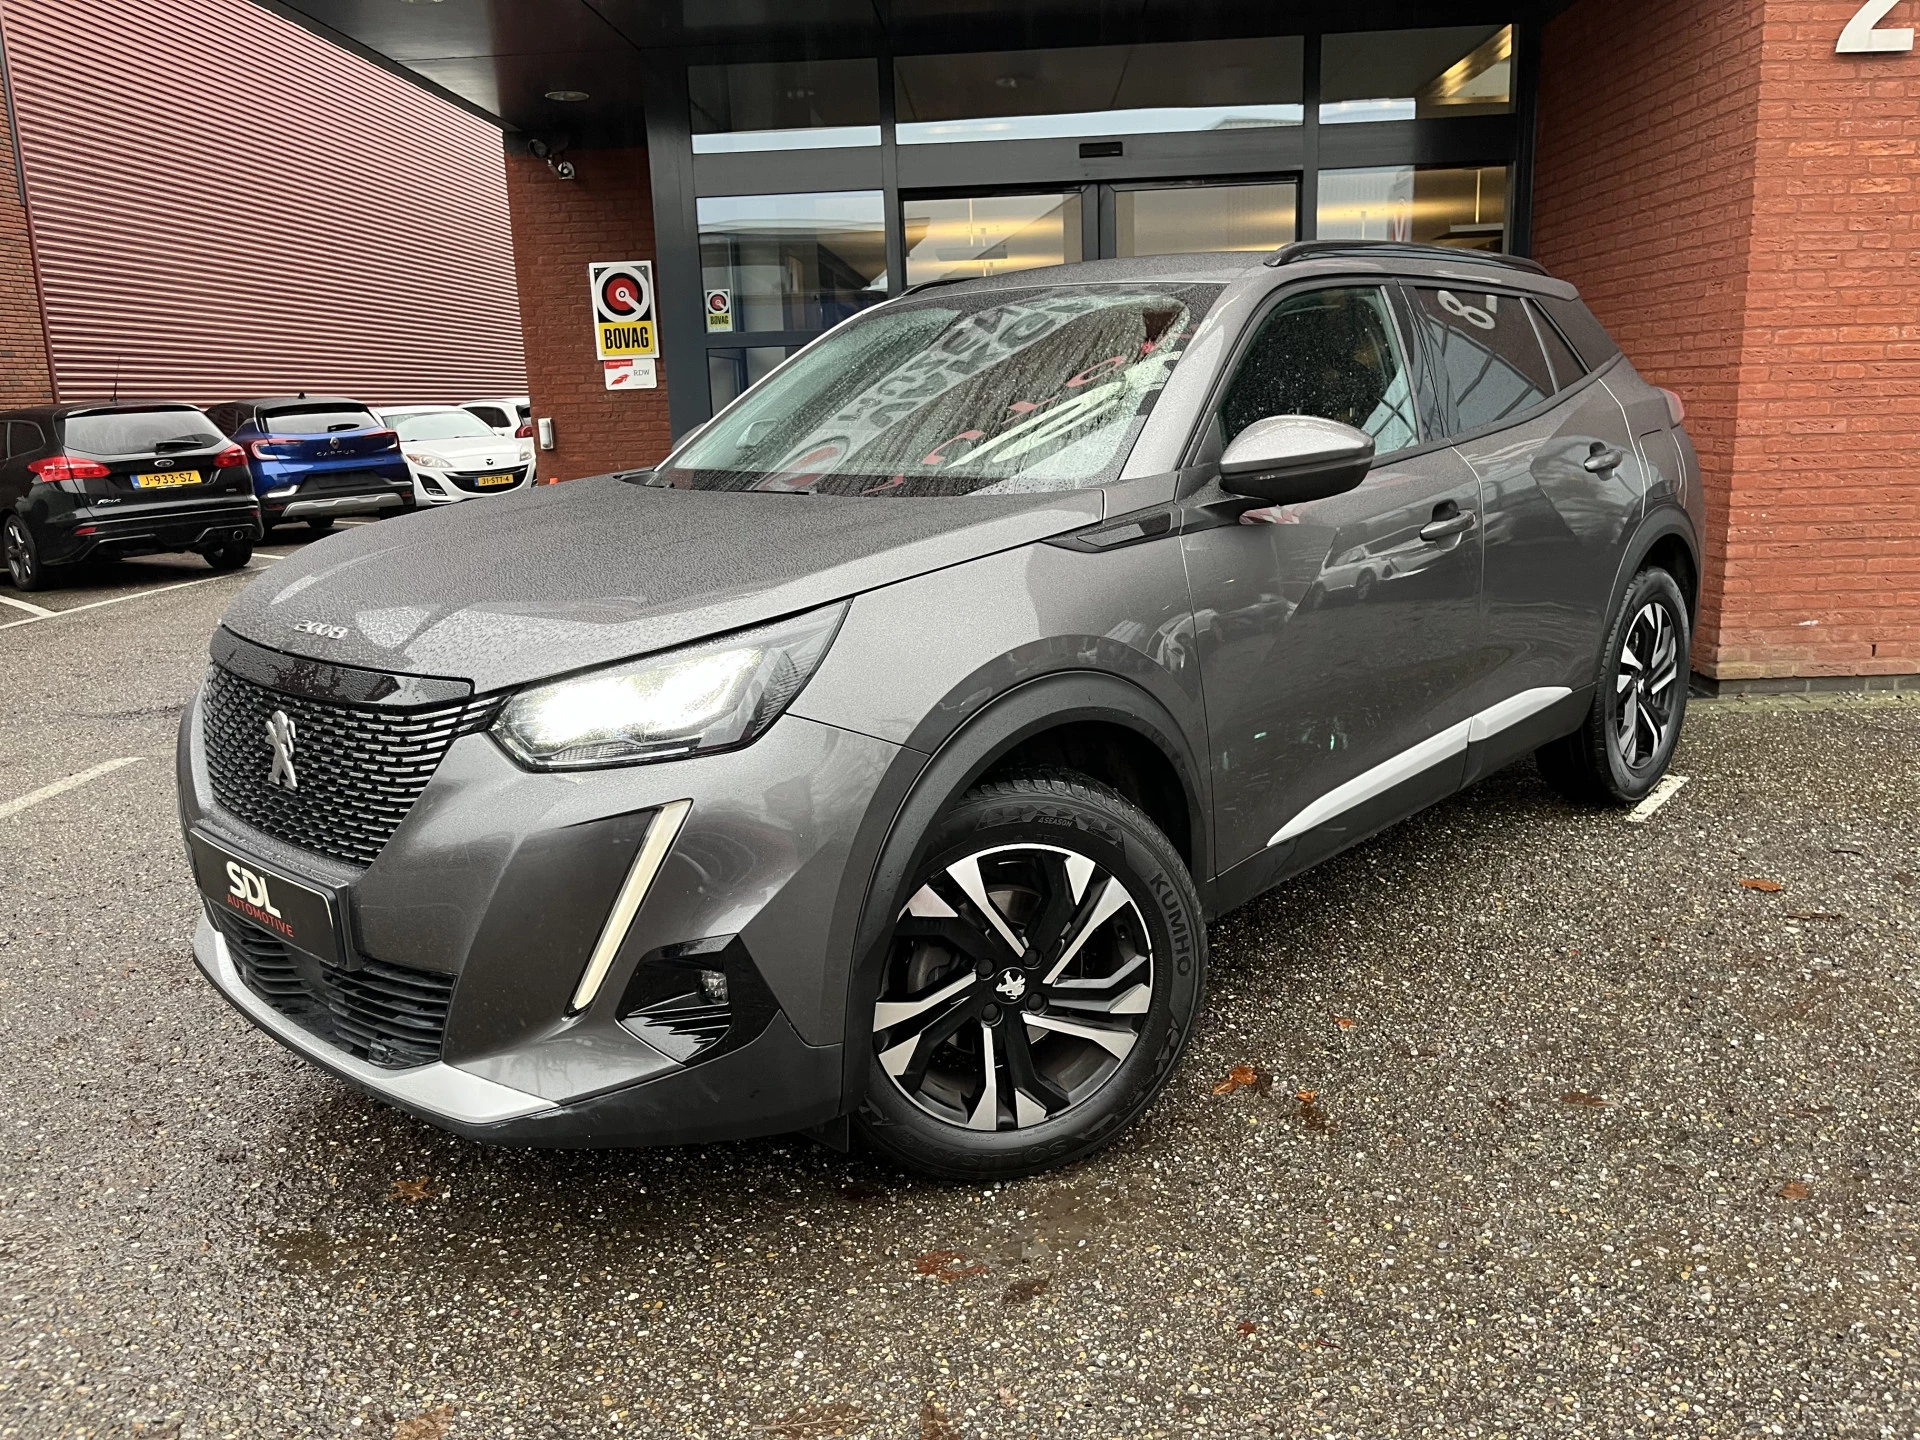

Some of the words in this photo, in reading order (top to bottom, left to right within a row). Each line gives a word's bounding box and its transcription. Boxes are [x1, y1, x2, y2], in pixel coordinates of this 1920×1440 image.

[709, 315, 729, 325] BOVAG
[604, 326, 650, 350] BOVAG
[633, 369, 650, 377] RDW
[145, 472, 194, 486] J-933-SZ
[482, 476, 509, 485] 31-STT-4
[293, 619, 349, 640] 2008
[1037, 816, 1073, 828] 4SEASON
[226, 860, 281, 919] SDL
[226, 893, 295, 938] AUTOMOTIVE
[1149, 872, 1192, 976] KUMHO
